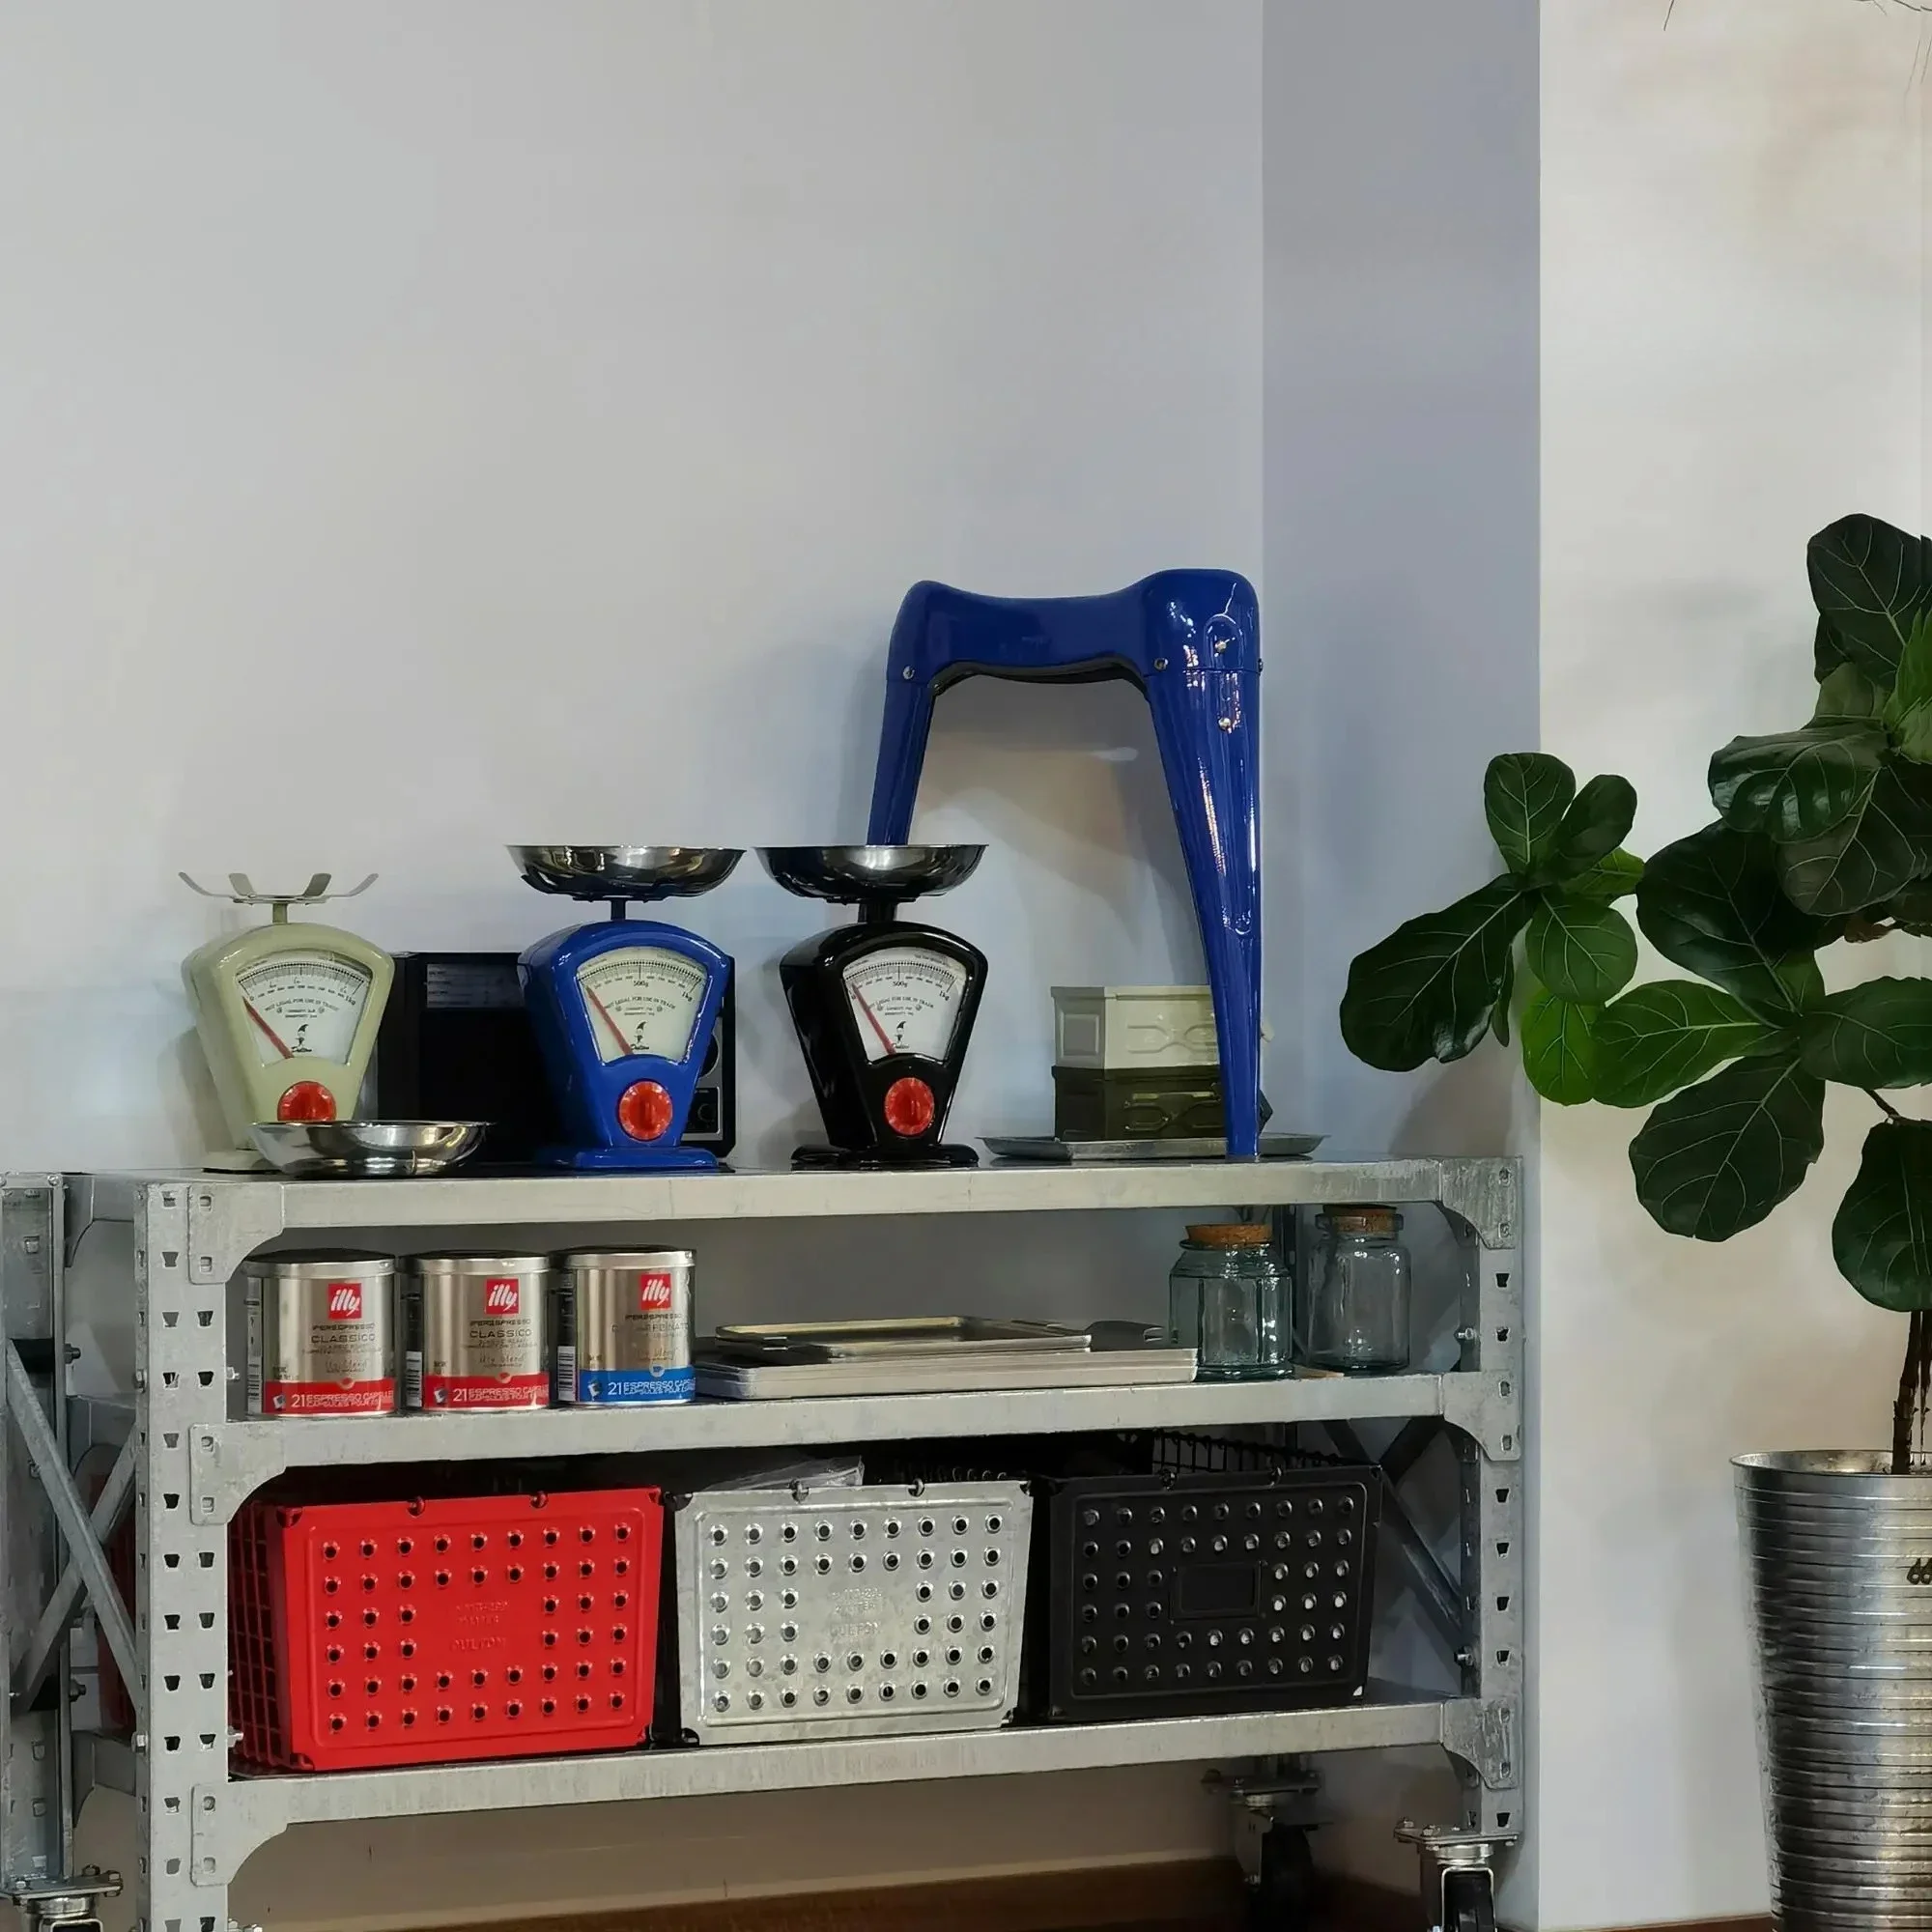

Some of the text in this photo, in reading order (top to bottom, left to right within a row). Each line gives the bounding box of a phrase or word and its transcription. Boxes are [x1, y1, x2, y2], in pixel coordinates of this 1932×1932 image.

[488, 1284, 518, 1312] illy
[642, 1279, 670, 1306] illy
[330, 1289, 360, 1317] illy
[311, 1333, 376, 1343] CLASSICO
[469, 1328, 532, 1338] CLASSICO
[608, 1381, 621, 1395] 21
[623, 1379, 674, 1389] ESPRESSO
[291, 1394, 305, 1407] 21
[453, 1388, 467, 1402] 21
